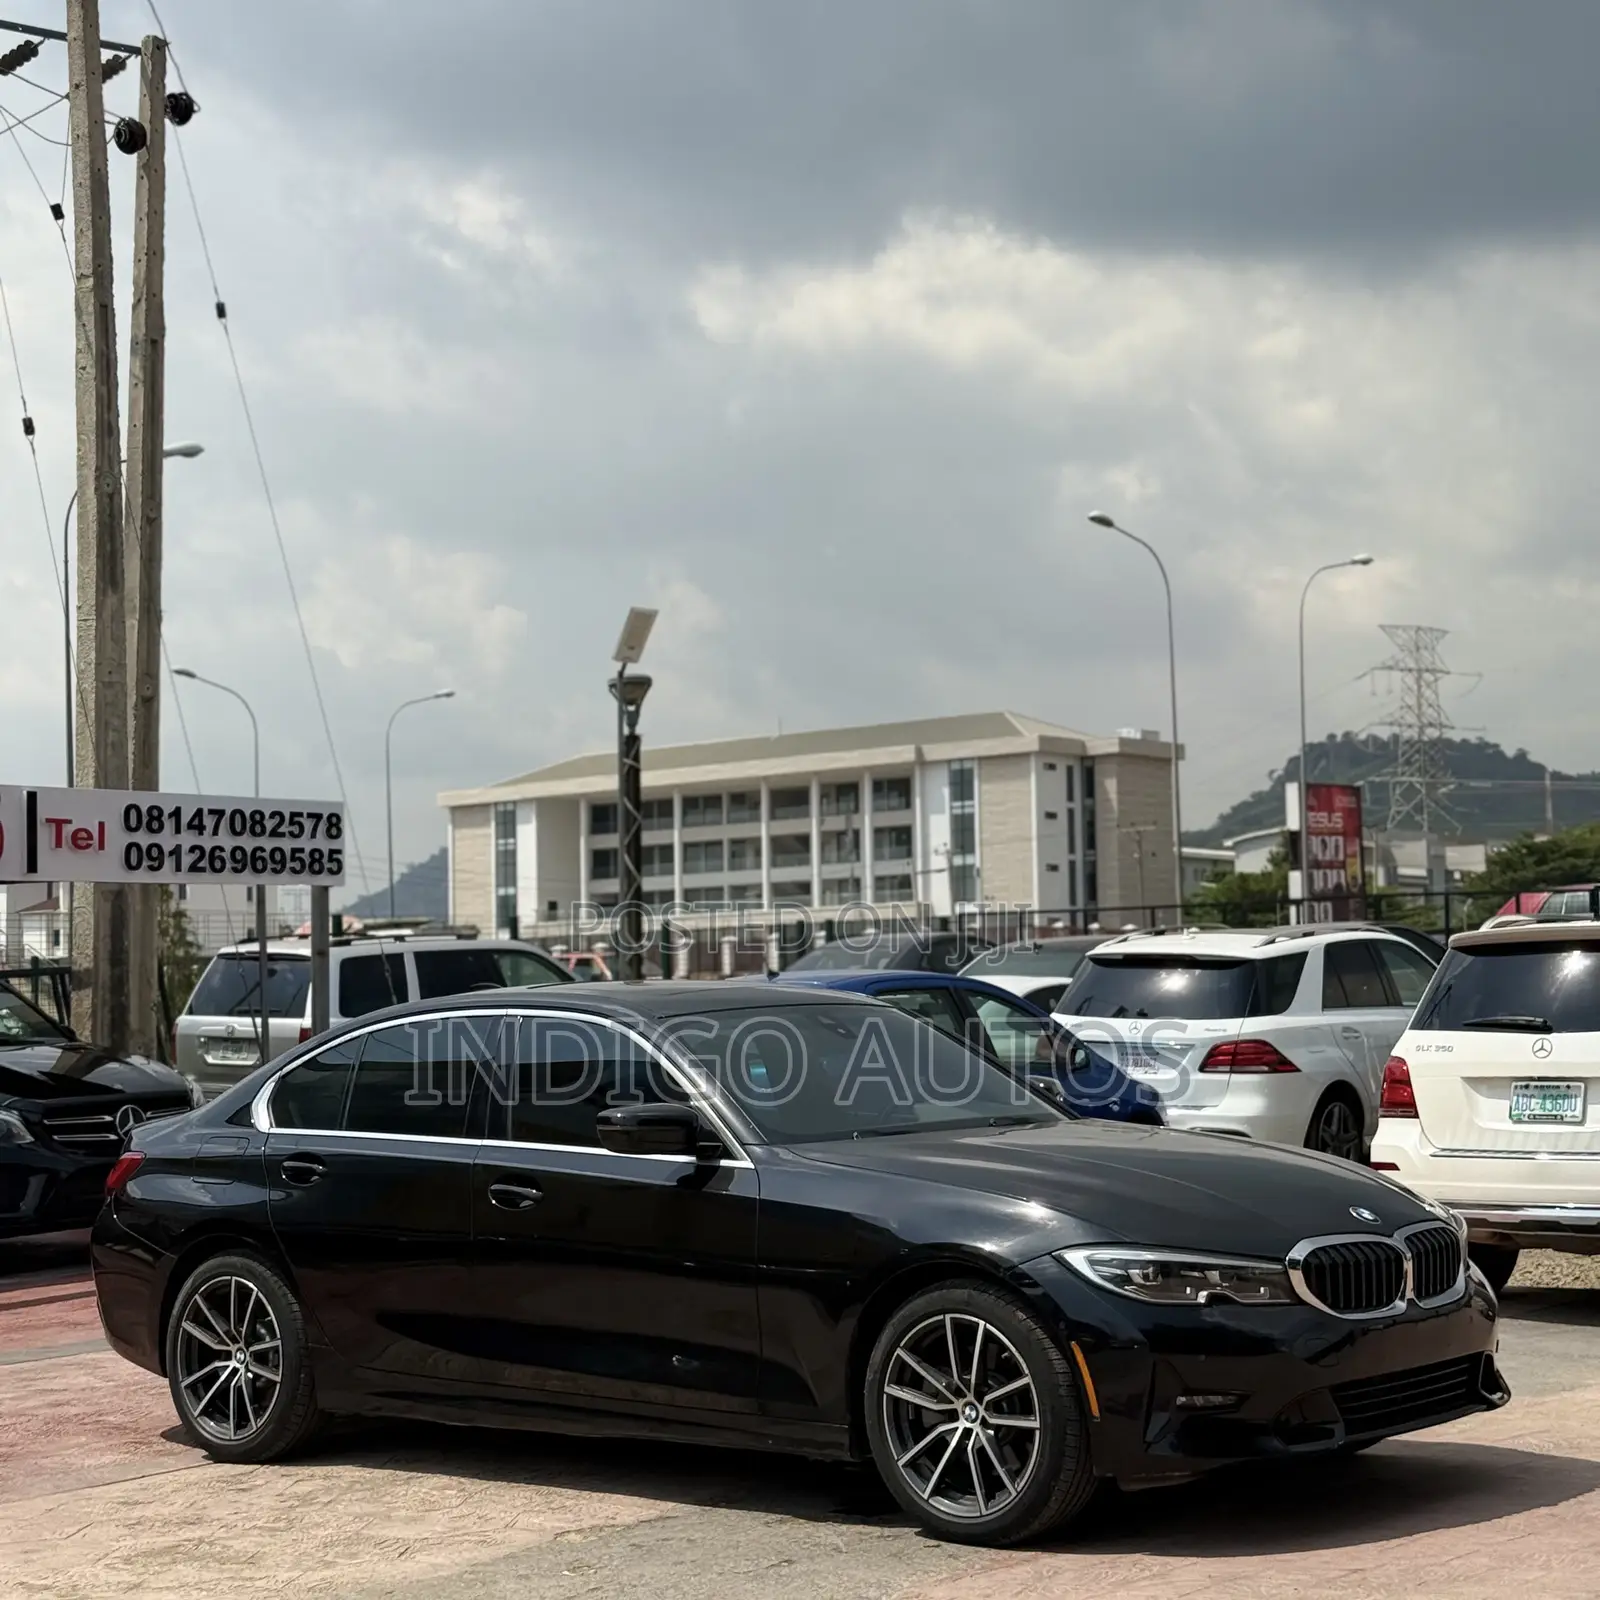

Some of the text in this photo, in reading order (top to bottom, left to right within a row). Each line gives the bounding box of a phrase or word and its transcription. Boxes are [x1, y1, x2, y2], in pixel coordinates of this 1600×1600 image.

[45, 817, 106, 850] Tel
[122, 803, 343, 840] 08147082578
[123, 841, 344, 875] 09126969585
